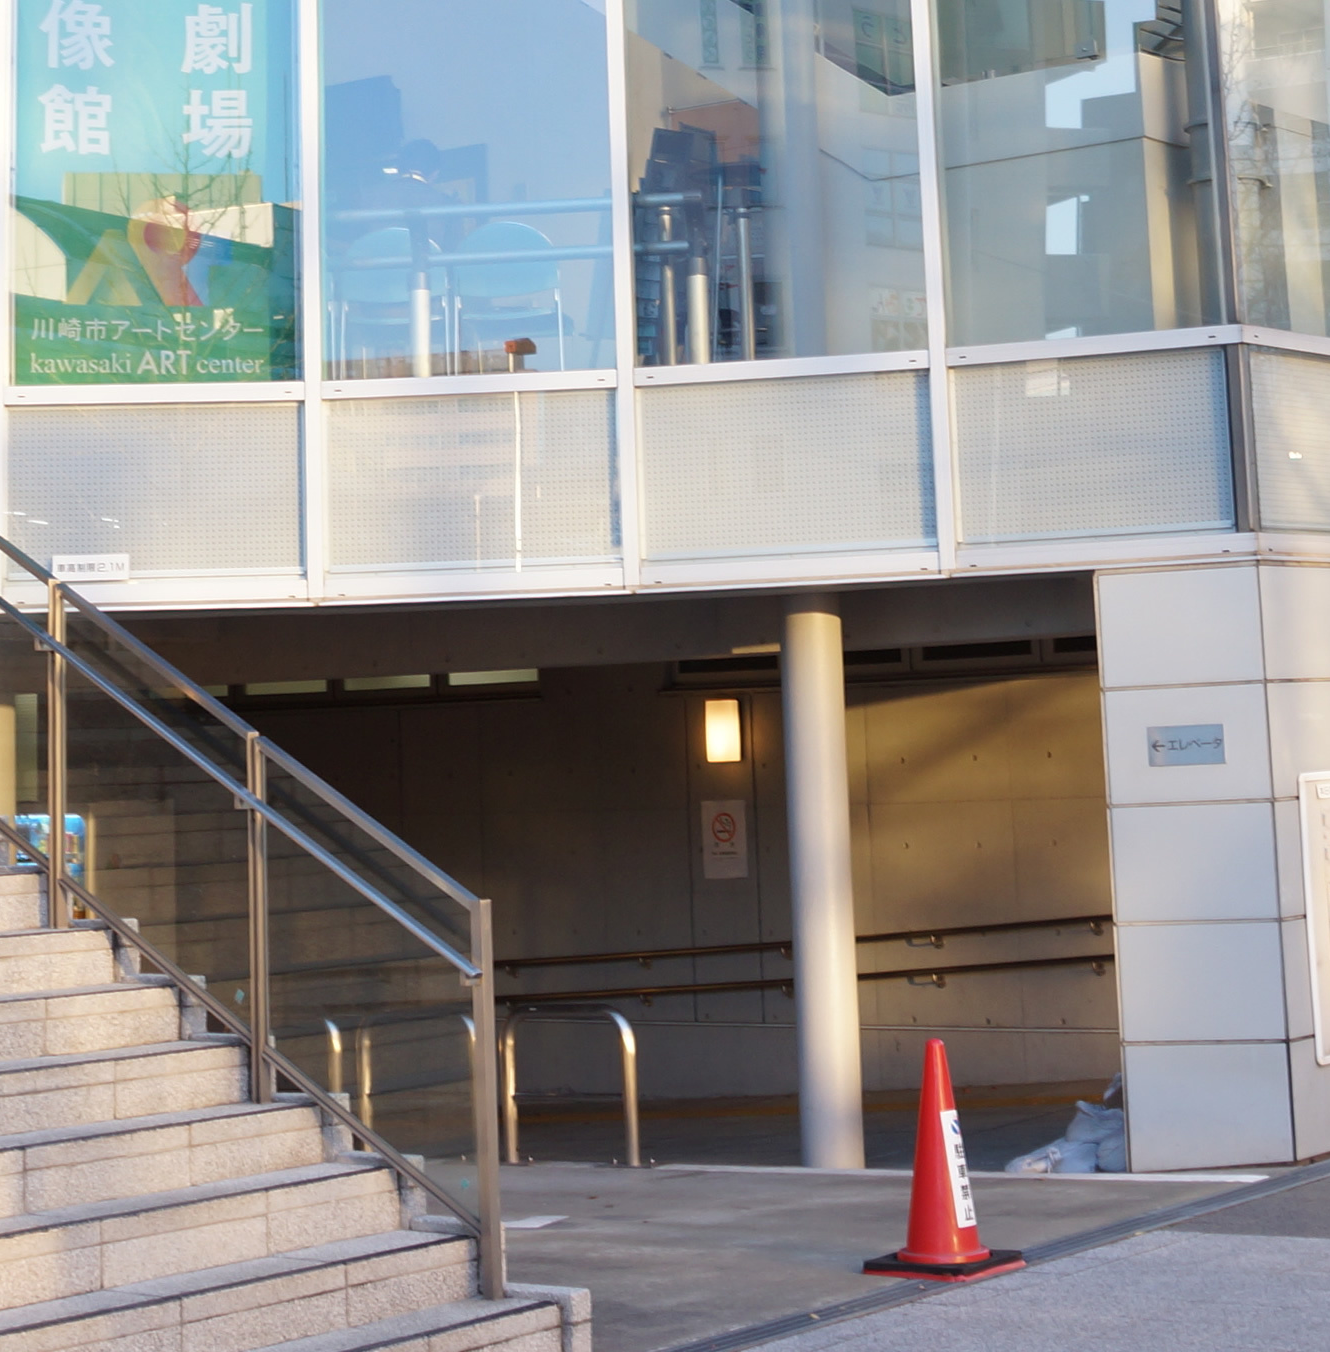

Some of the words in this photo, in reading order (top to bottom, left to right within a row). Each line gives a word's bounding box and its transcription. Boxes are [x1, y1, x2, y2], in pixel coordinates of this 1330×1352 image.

[31, 318, 264, 341] 川崎市アートセンター
[30, 352, 133, 374] kawasaki
[136, 350, 192, 375] ART
[196, 355, 265, 374] center
